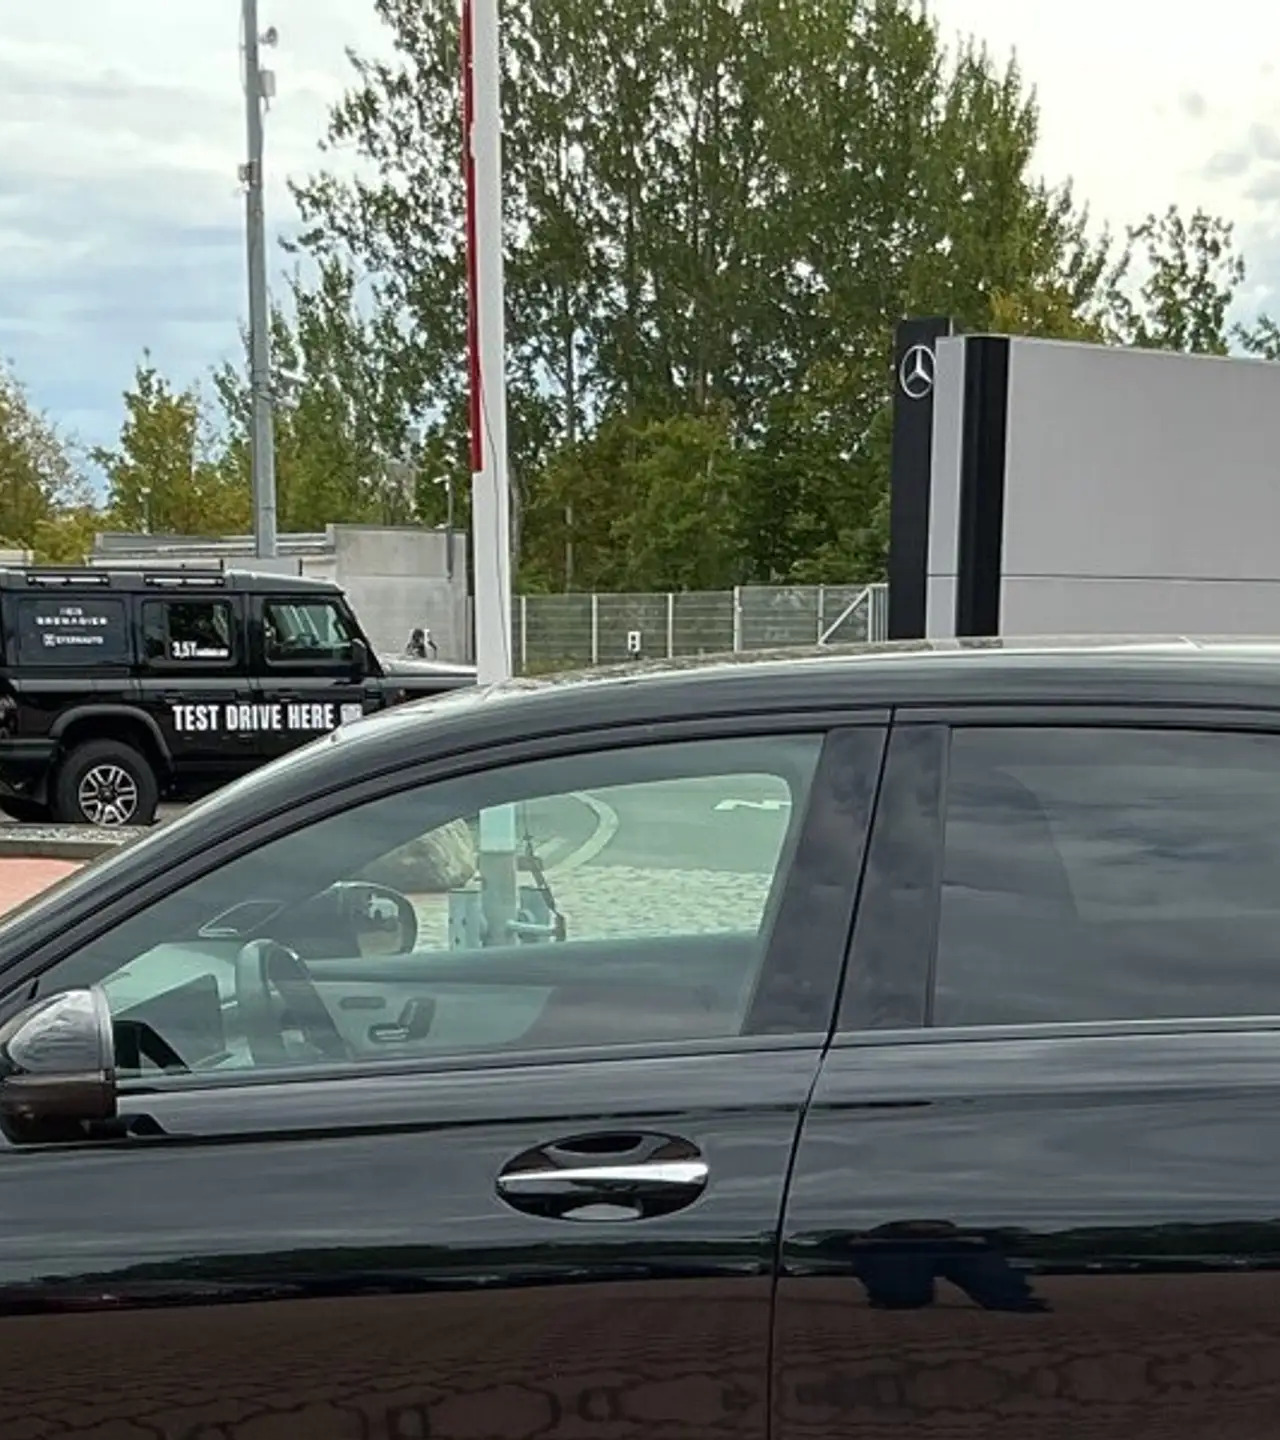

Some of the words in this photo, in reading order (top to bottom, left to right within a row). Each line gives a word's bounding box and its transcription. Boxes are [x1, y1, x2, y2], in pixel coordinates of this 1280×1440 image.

[172, 704, 219, 731] TEST
[225, 704, 282, 731] DRIVE
[287, 703, 335, 730] HERE
